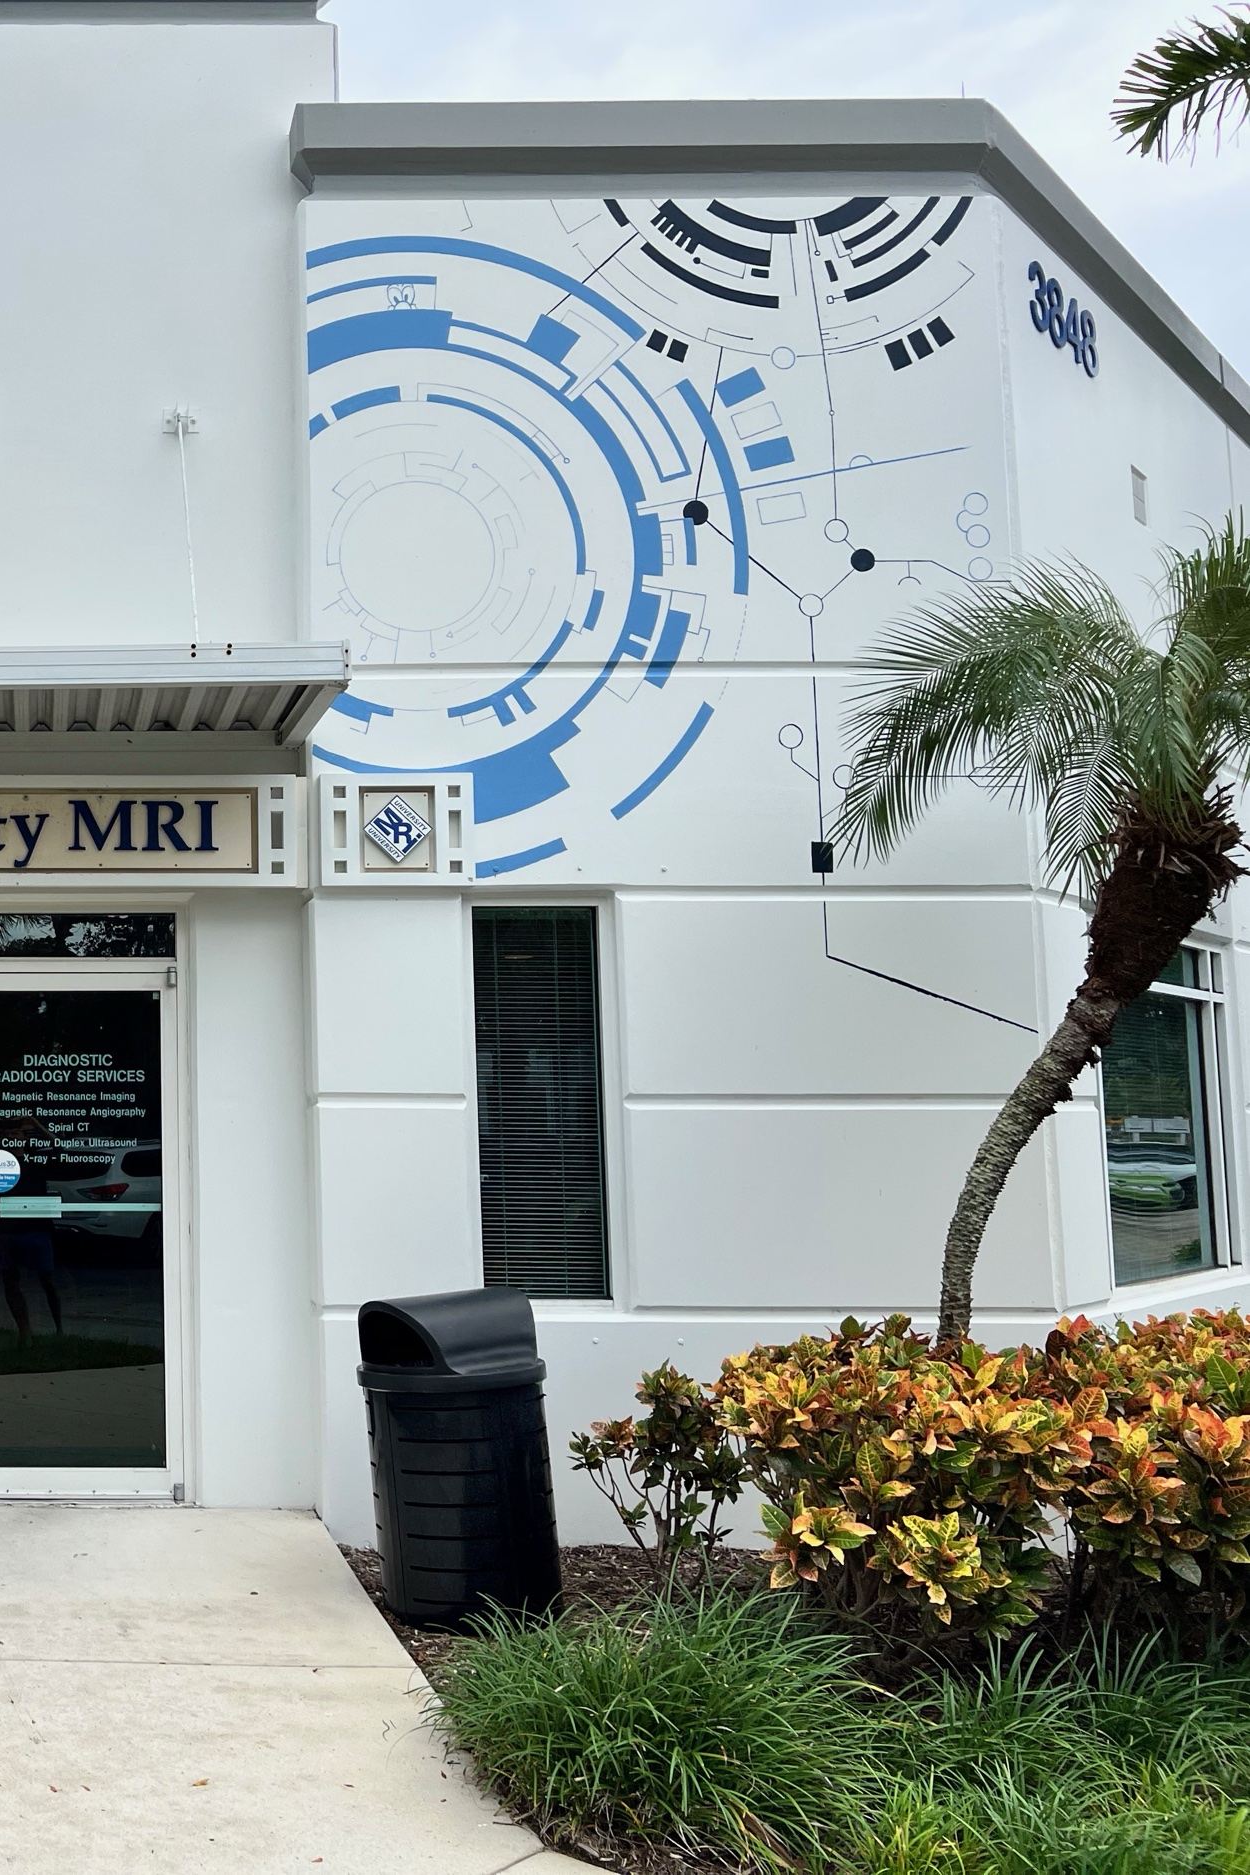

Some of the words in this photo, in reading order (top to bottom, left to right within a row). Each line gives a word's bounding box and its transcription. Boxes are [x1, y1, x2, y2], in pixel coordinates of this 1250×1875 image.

[1028, 260, 1100, 378] 3848
[393, 800, 428, 831] UNIVERSITY
[68, 800, 220, 852] MRI
[367, 827, 401, 859] UNIVERSITY
[23, 1053, 113, 1067] DIAGNOSTIC
[77, 1069, 145, 1082] SERVICES
[2, 1092, 44, 1103] Magnetic
[46, 1092, 97, 1101] Resonance
[100, 1092, 136, 1103] Imaging
[36, 1107, 87, 1116] Resonance
[90, 1107, 146, 1118] Angiography
[48, 1122, 74, 1132] Spiral
[77, 1122, 90, 1131] CT
[1, 1138, 26, 1147] Color
[29, 1138, 51, 1147] Flow
[54, 1138, 85, 1148] Duplex
[88, 1138, 137, 1147] Ultrasound
[23, 1154, 48, 1164] X-ray
[60, 1153, 116, 1164] Fluoroscopy
